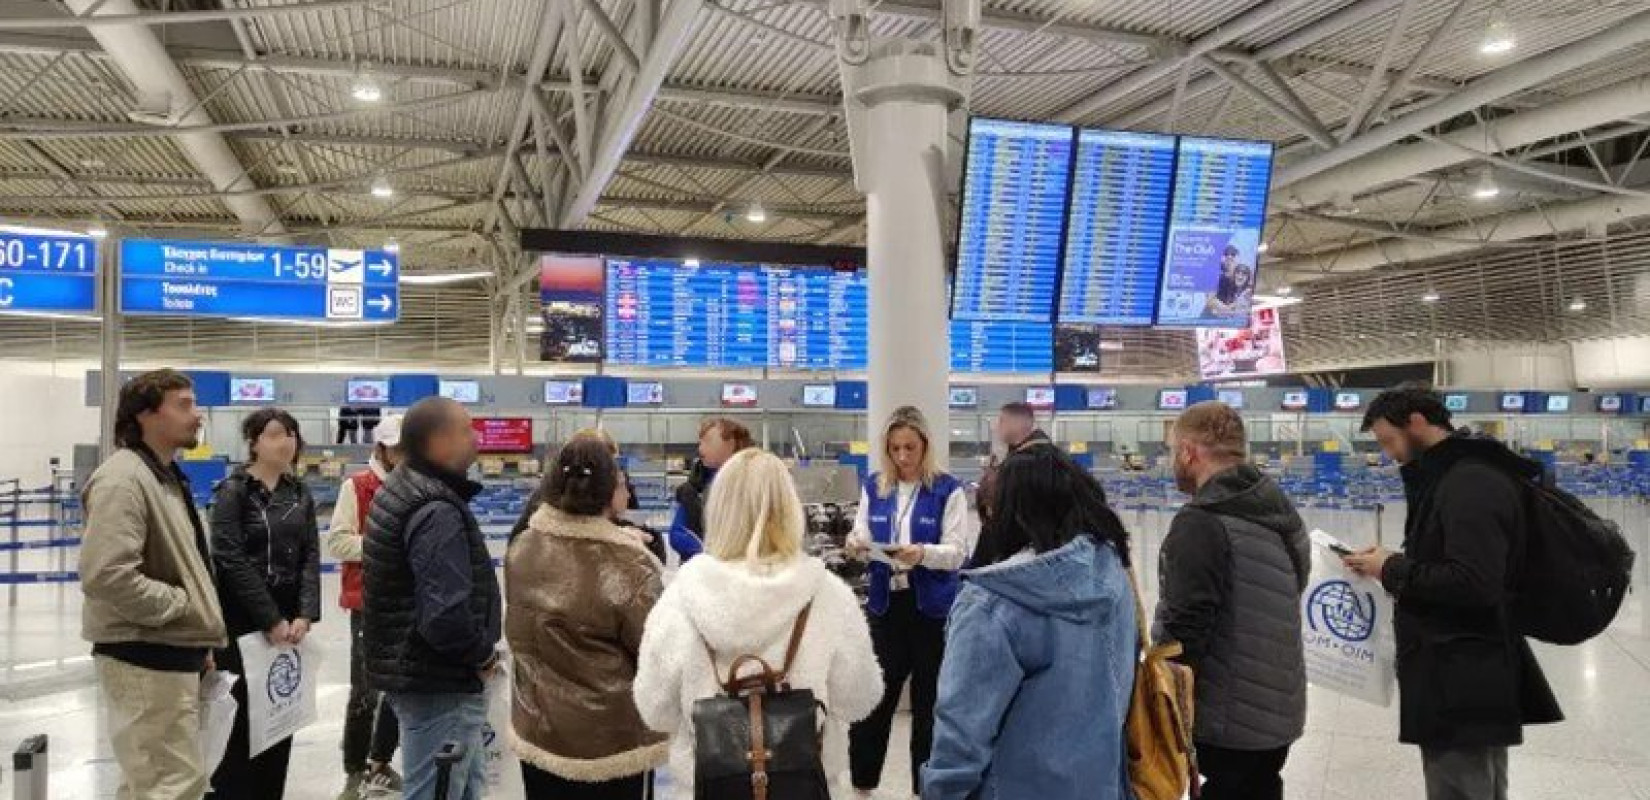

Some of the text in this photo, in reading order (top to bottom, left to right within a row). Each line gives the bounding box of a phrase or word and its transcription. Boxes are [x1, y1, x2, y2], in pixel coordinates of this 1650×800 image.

[164, 261, 195, 273] Check
[270, 252, 325, 279] 1-59
[334, 296, 354, 308] WC
